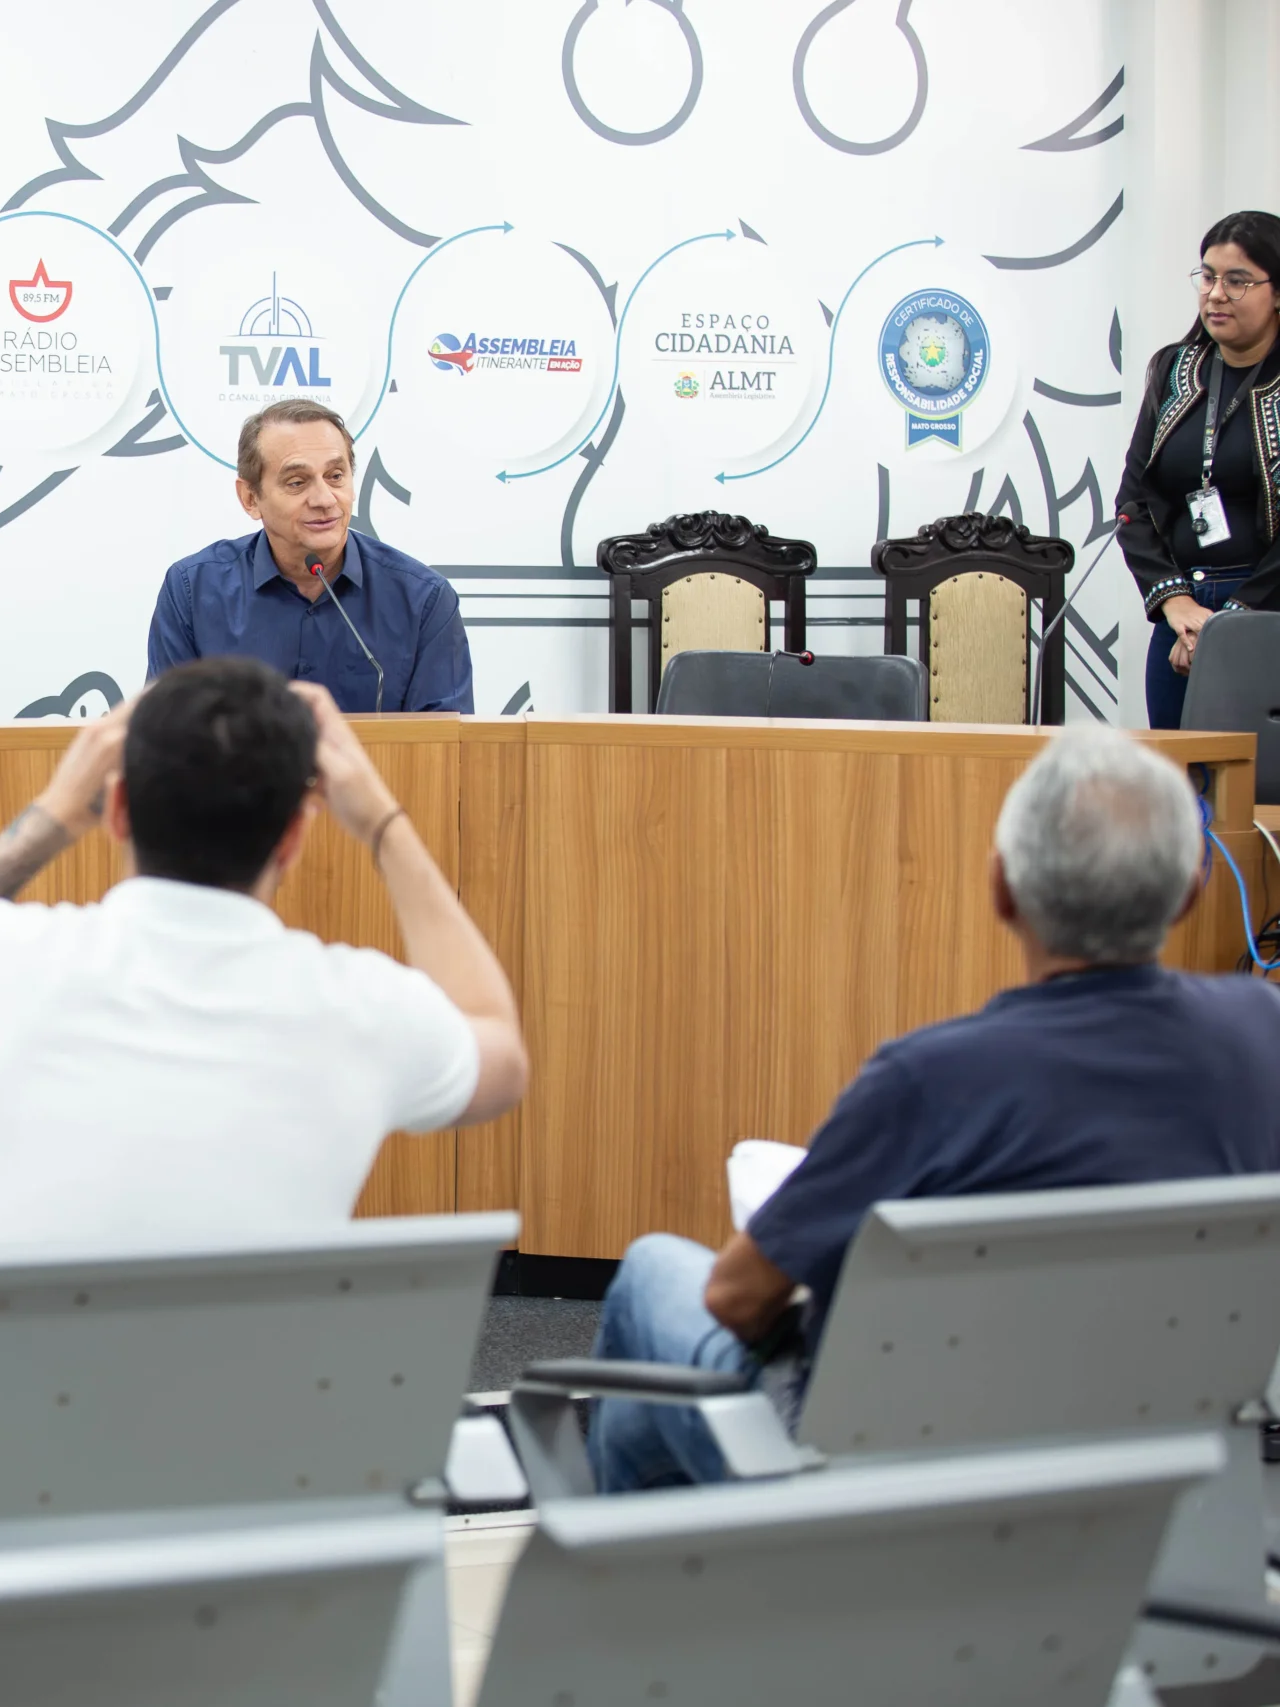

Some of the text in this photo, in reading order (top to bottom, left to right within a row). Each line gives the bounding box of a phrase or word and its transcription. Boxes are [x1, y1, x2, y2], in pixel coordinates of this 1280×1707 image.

[43, 293, 60, 303] FM
[681, 313, 770, 332] ESPAÇO
[894, 297, 974, 327] CERTIFICADO DE
[4, 327, 77, 350] RÁDIO
[462, 333, 577, 356] ASSEMBLEIA
[655, 333, 795, 355] CIDADANIA
[220, 345, 331, 387] TVAL
[476, 356, 547, 370] ITINERANTE
[709, 371, 776, 391] ALMT
[885, 348, 984, 411] RESPONSABILIDADE SOCIAL
[229, 394, 260, 402] CANAL
[263, 395, 277, 403] DA
